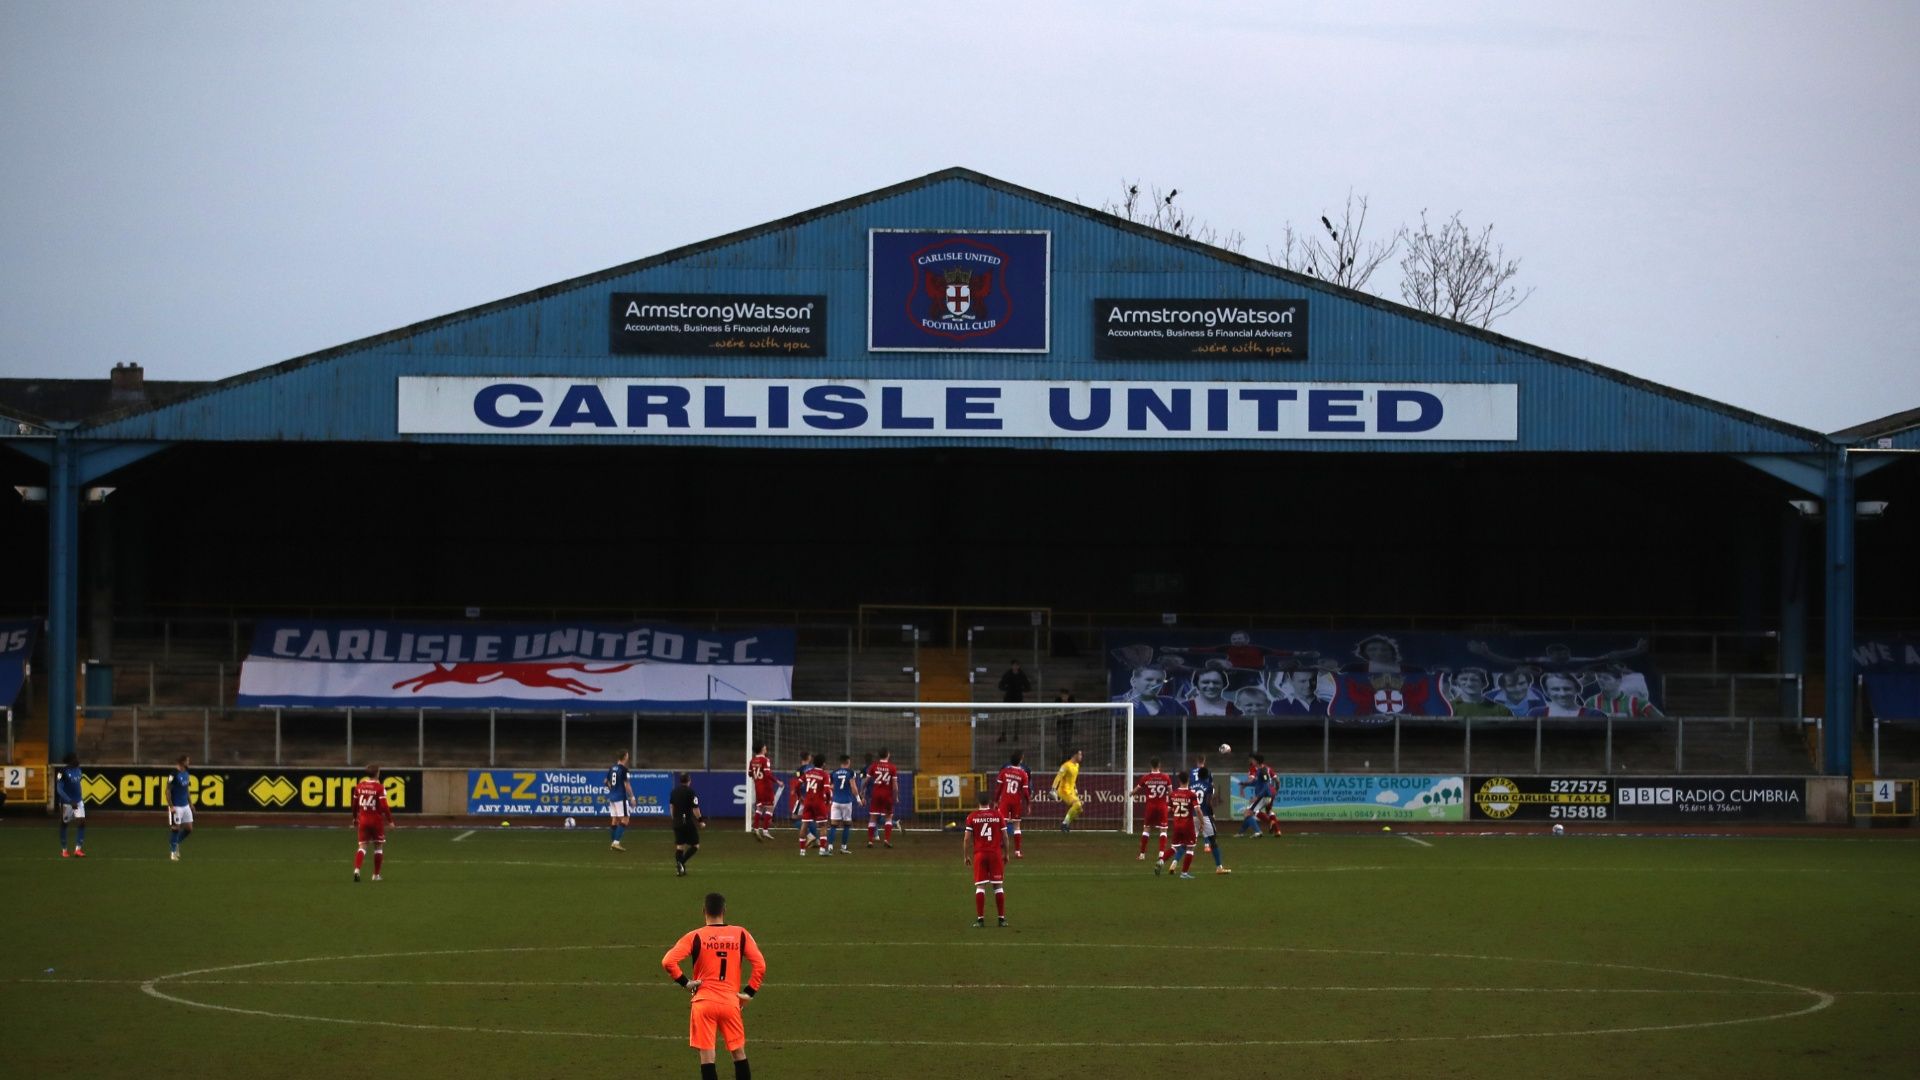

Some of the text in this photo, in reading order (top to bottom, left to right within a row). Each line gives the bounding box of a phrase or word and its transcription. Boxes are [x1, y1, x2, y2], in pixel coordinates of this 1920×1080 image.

[918, 252, 1001, 266] CARLISLE UNITED
[625, 323, 810, 334] Accountants, Business & Financial Advisers
[922, 319, 997, 331] FOOTBALL CLUB
[1107, 329, 1293, 339] Accountants, Business & Financial Advisers
[749, 337, 780, 349] with
[783, 341, 811, 351] you
[1232, 341, 1263, 353] with
[1266, 345, 1293, 356] you
[474, 383, 1443, 433] CARLISLE UNITED
[273, 628, 774, 664] CARLISLE UNITED F.C.
[10, 769, 20, 786] 2
[545, 773, 587, 785] Vehicle
[612, 772, 617, 786] 8
[752, 767, 764, 780] 16
[874, 771, 892, 786] 24
[472, 772, 537, 800] A-Z
[806, 778, 818, 794] 14
[838, 775, 847, 789] 7
[1005, 778, 1019, 794] 10
[1324, 777, 1374, 789] WASTE
[1379, 777, 1431, 789] GROUP
[1550, 780, 1608, 792] 527575
[541, 783, 611, 796] Dismantlers
[1147, 785, 1166, 799] 39
[1620, 788, 1800, 804] BBC RADIO CUMBRIA
[1879, 783, 1889, 799] 4
[359, 794, 377, 811] 44
[541, 795, 593, 805] 01228
[1477, 794, 1607, 802] RADIO CARLISLE TAXIS
[477, 804, 501, 813] ANY
[504, 805, 533, 815] PART,
[536, 805, 559, 814] ANY
[562, 805, 598, 816] MAKE,
[1172, 801, 1190, 817] 25
[1549, 805, 1608, 818] 515818
[1708, 803, 1714, 812] &
[980, 822, 993, 842] 4
[706, 942, 739, 951] MORRIS
